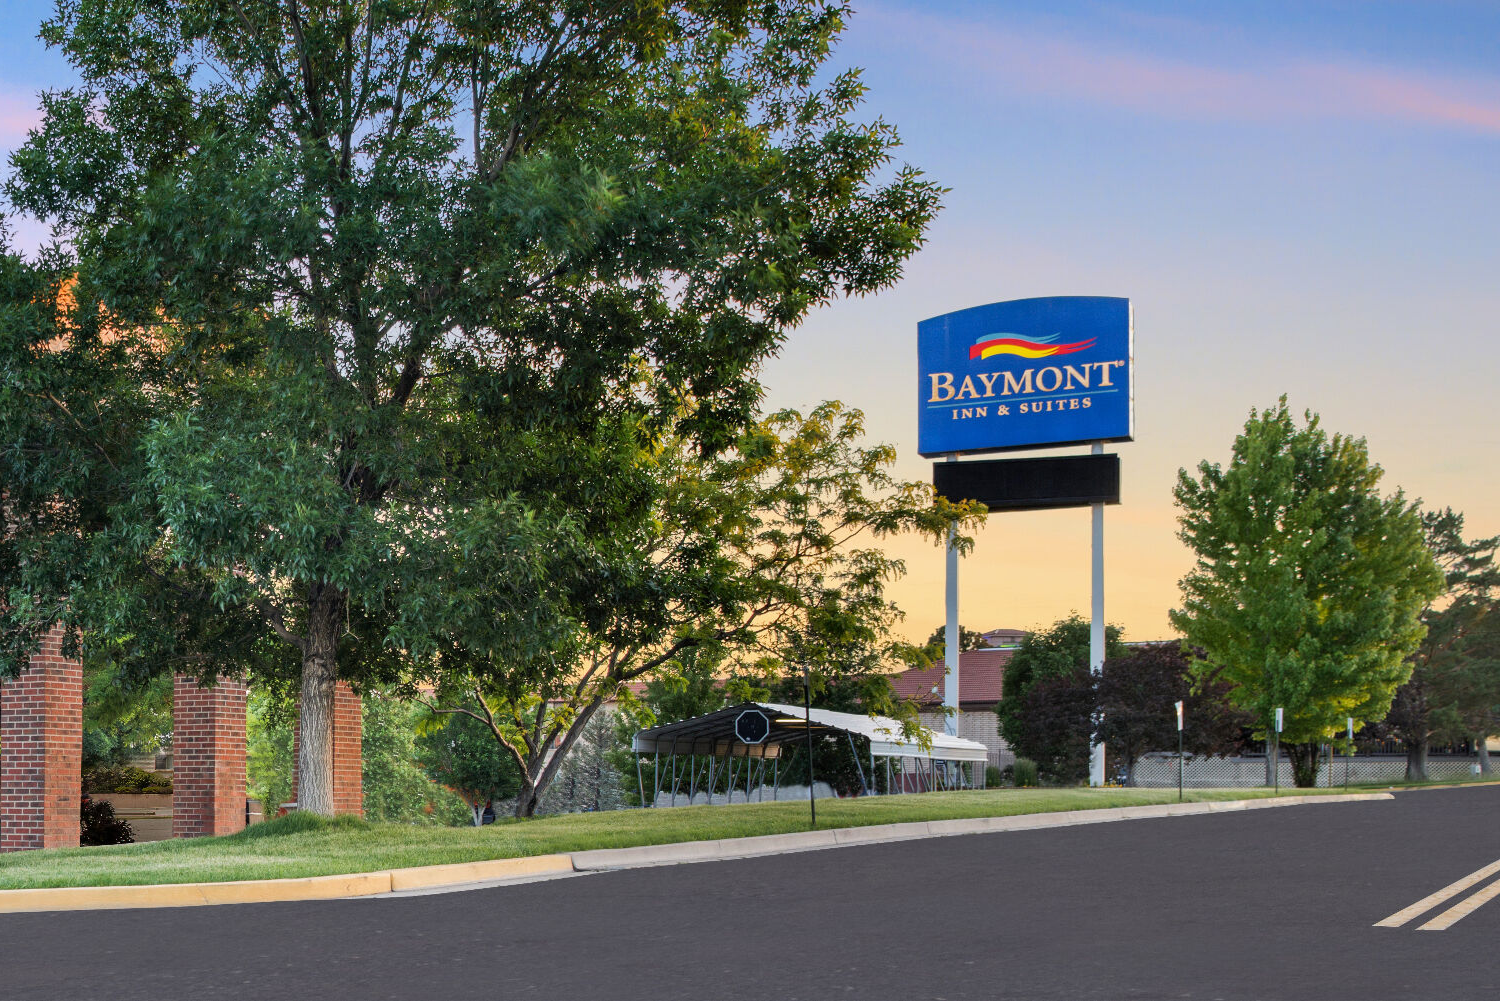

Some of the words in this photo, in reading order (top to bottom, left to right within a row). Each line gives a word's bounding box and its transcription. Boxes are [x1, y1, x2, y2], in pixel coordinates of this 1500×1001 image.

[928, 361, 1119, 402] BAYMONT
[952, 406, 988, 420] INN
[998, 405, 1009, 416] &
[1020, 397, 1092, 414] SUITES
